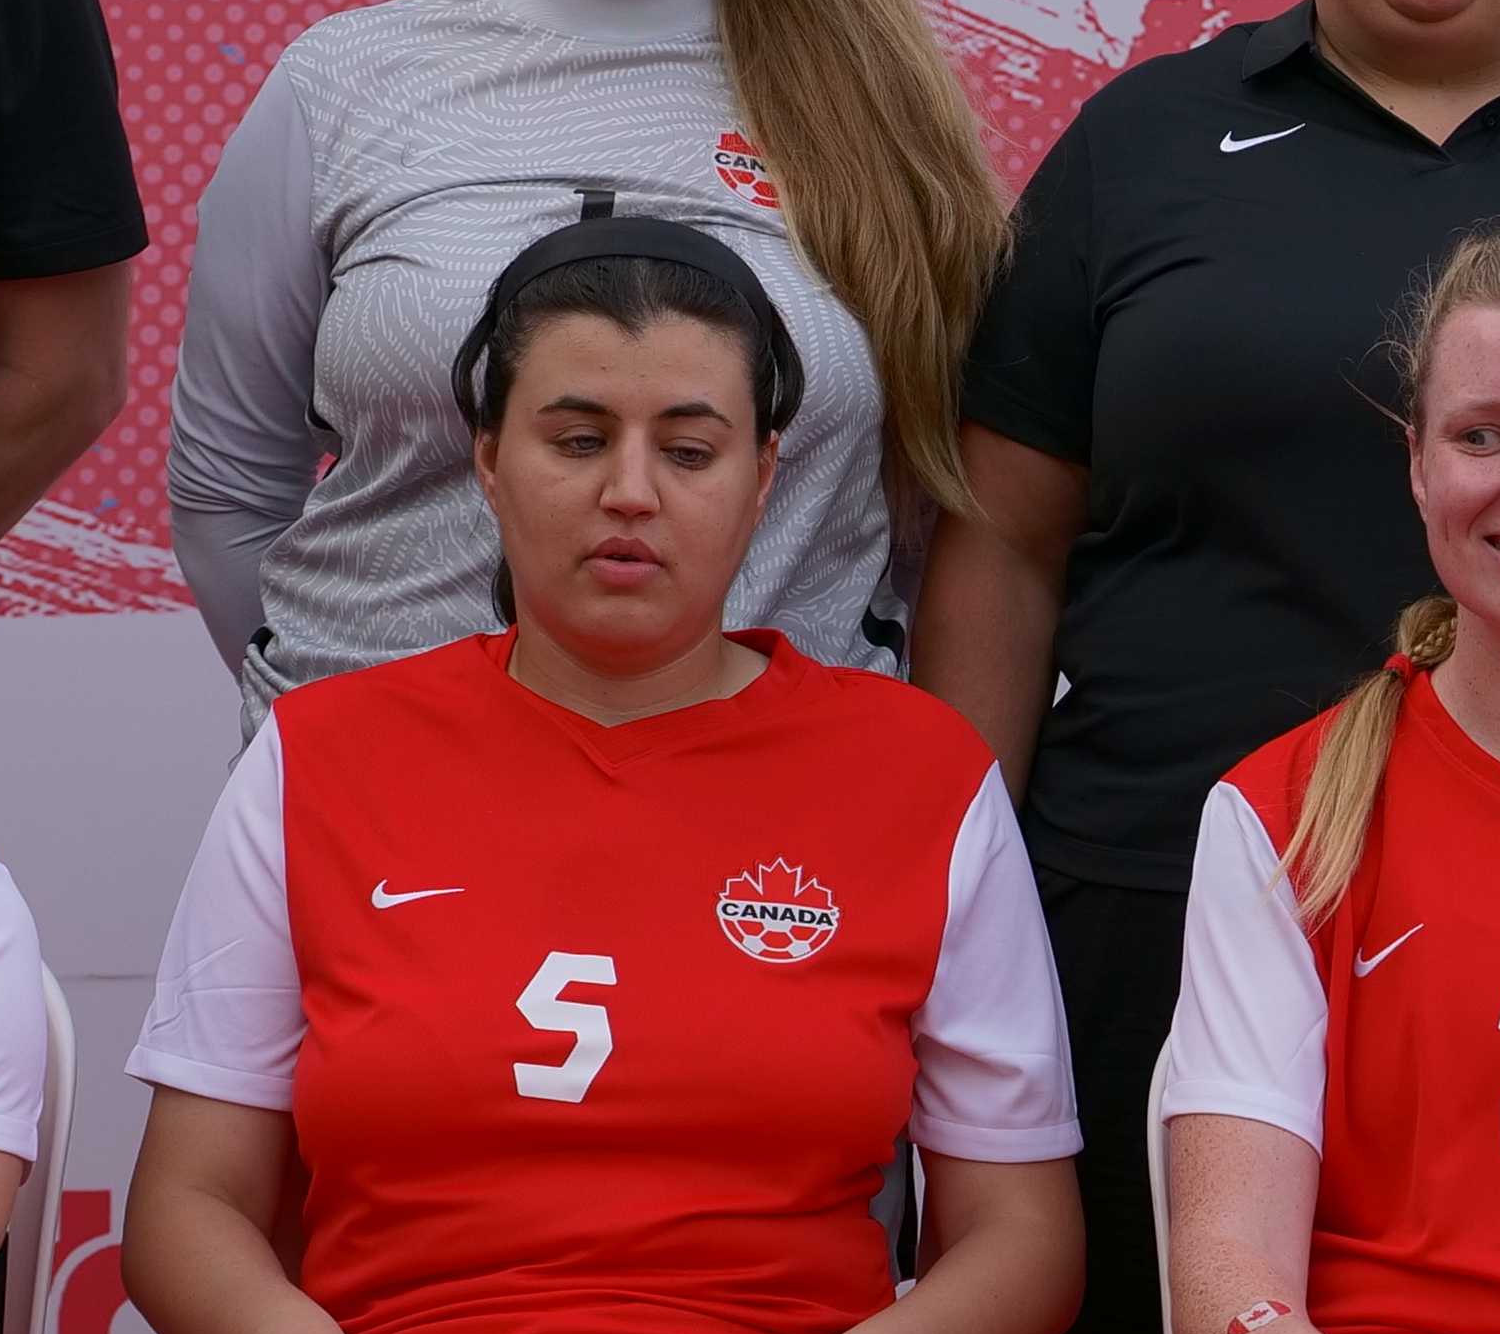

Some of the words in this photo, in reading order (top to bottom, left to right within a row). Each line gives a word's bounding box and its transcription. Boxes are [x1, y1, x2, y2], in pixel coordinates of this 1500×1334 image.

[714, 151, 767, 173] CAN
[721, 900, 836, 928] CANADA
[511, 951, 618, 1104] 5
